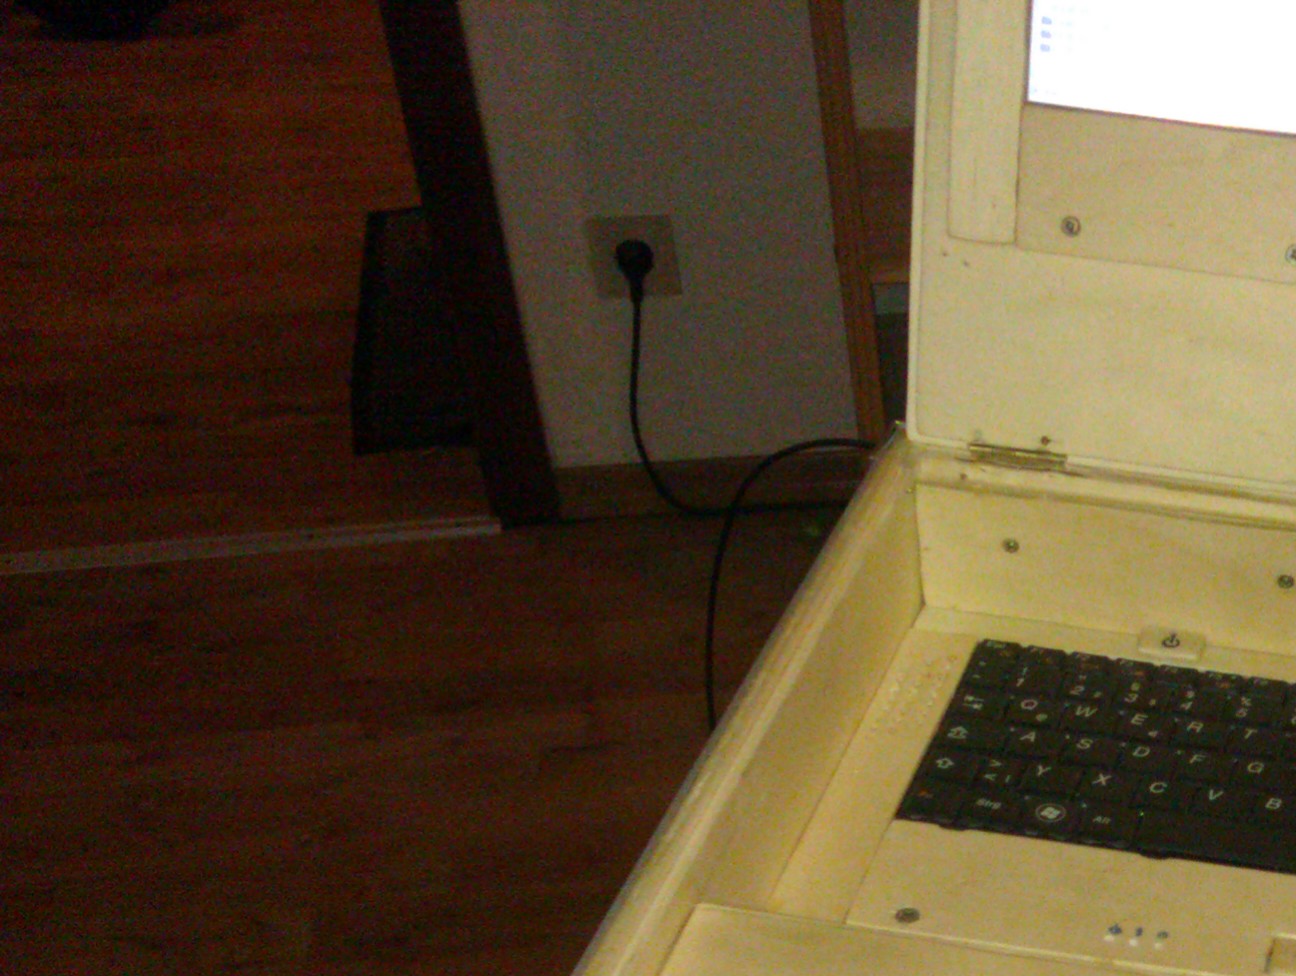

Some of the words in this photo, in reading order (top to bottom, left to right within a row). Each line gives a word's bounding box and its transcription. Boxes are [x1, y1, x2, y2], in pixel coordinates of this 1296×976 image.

[1074, 704, 1099, 719] W
[1129, 712, 1149, 727] E
[1185, 720, 1205, 734] R
[1243, 727, 1259, 740] T
[1018, 730, 1037, 744] A
[1075, 737, 1095, 751] S
[1131, 745, 1151, 758] D
[1188, 752, 1207, 765] F
[1246, 760, 1266, 775] G
[1035, 763, 1053, 778] Y
[1091, 772, 1113, 787] X
[1148, 780, 1169, 795] C
[1207, 788, 1225, 802] V
[1264, 796, 1284, 811] B
